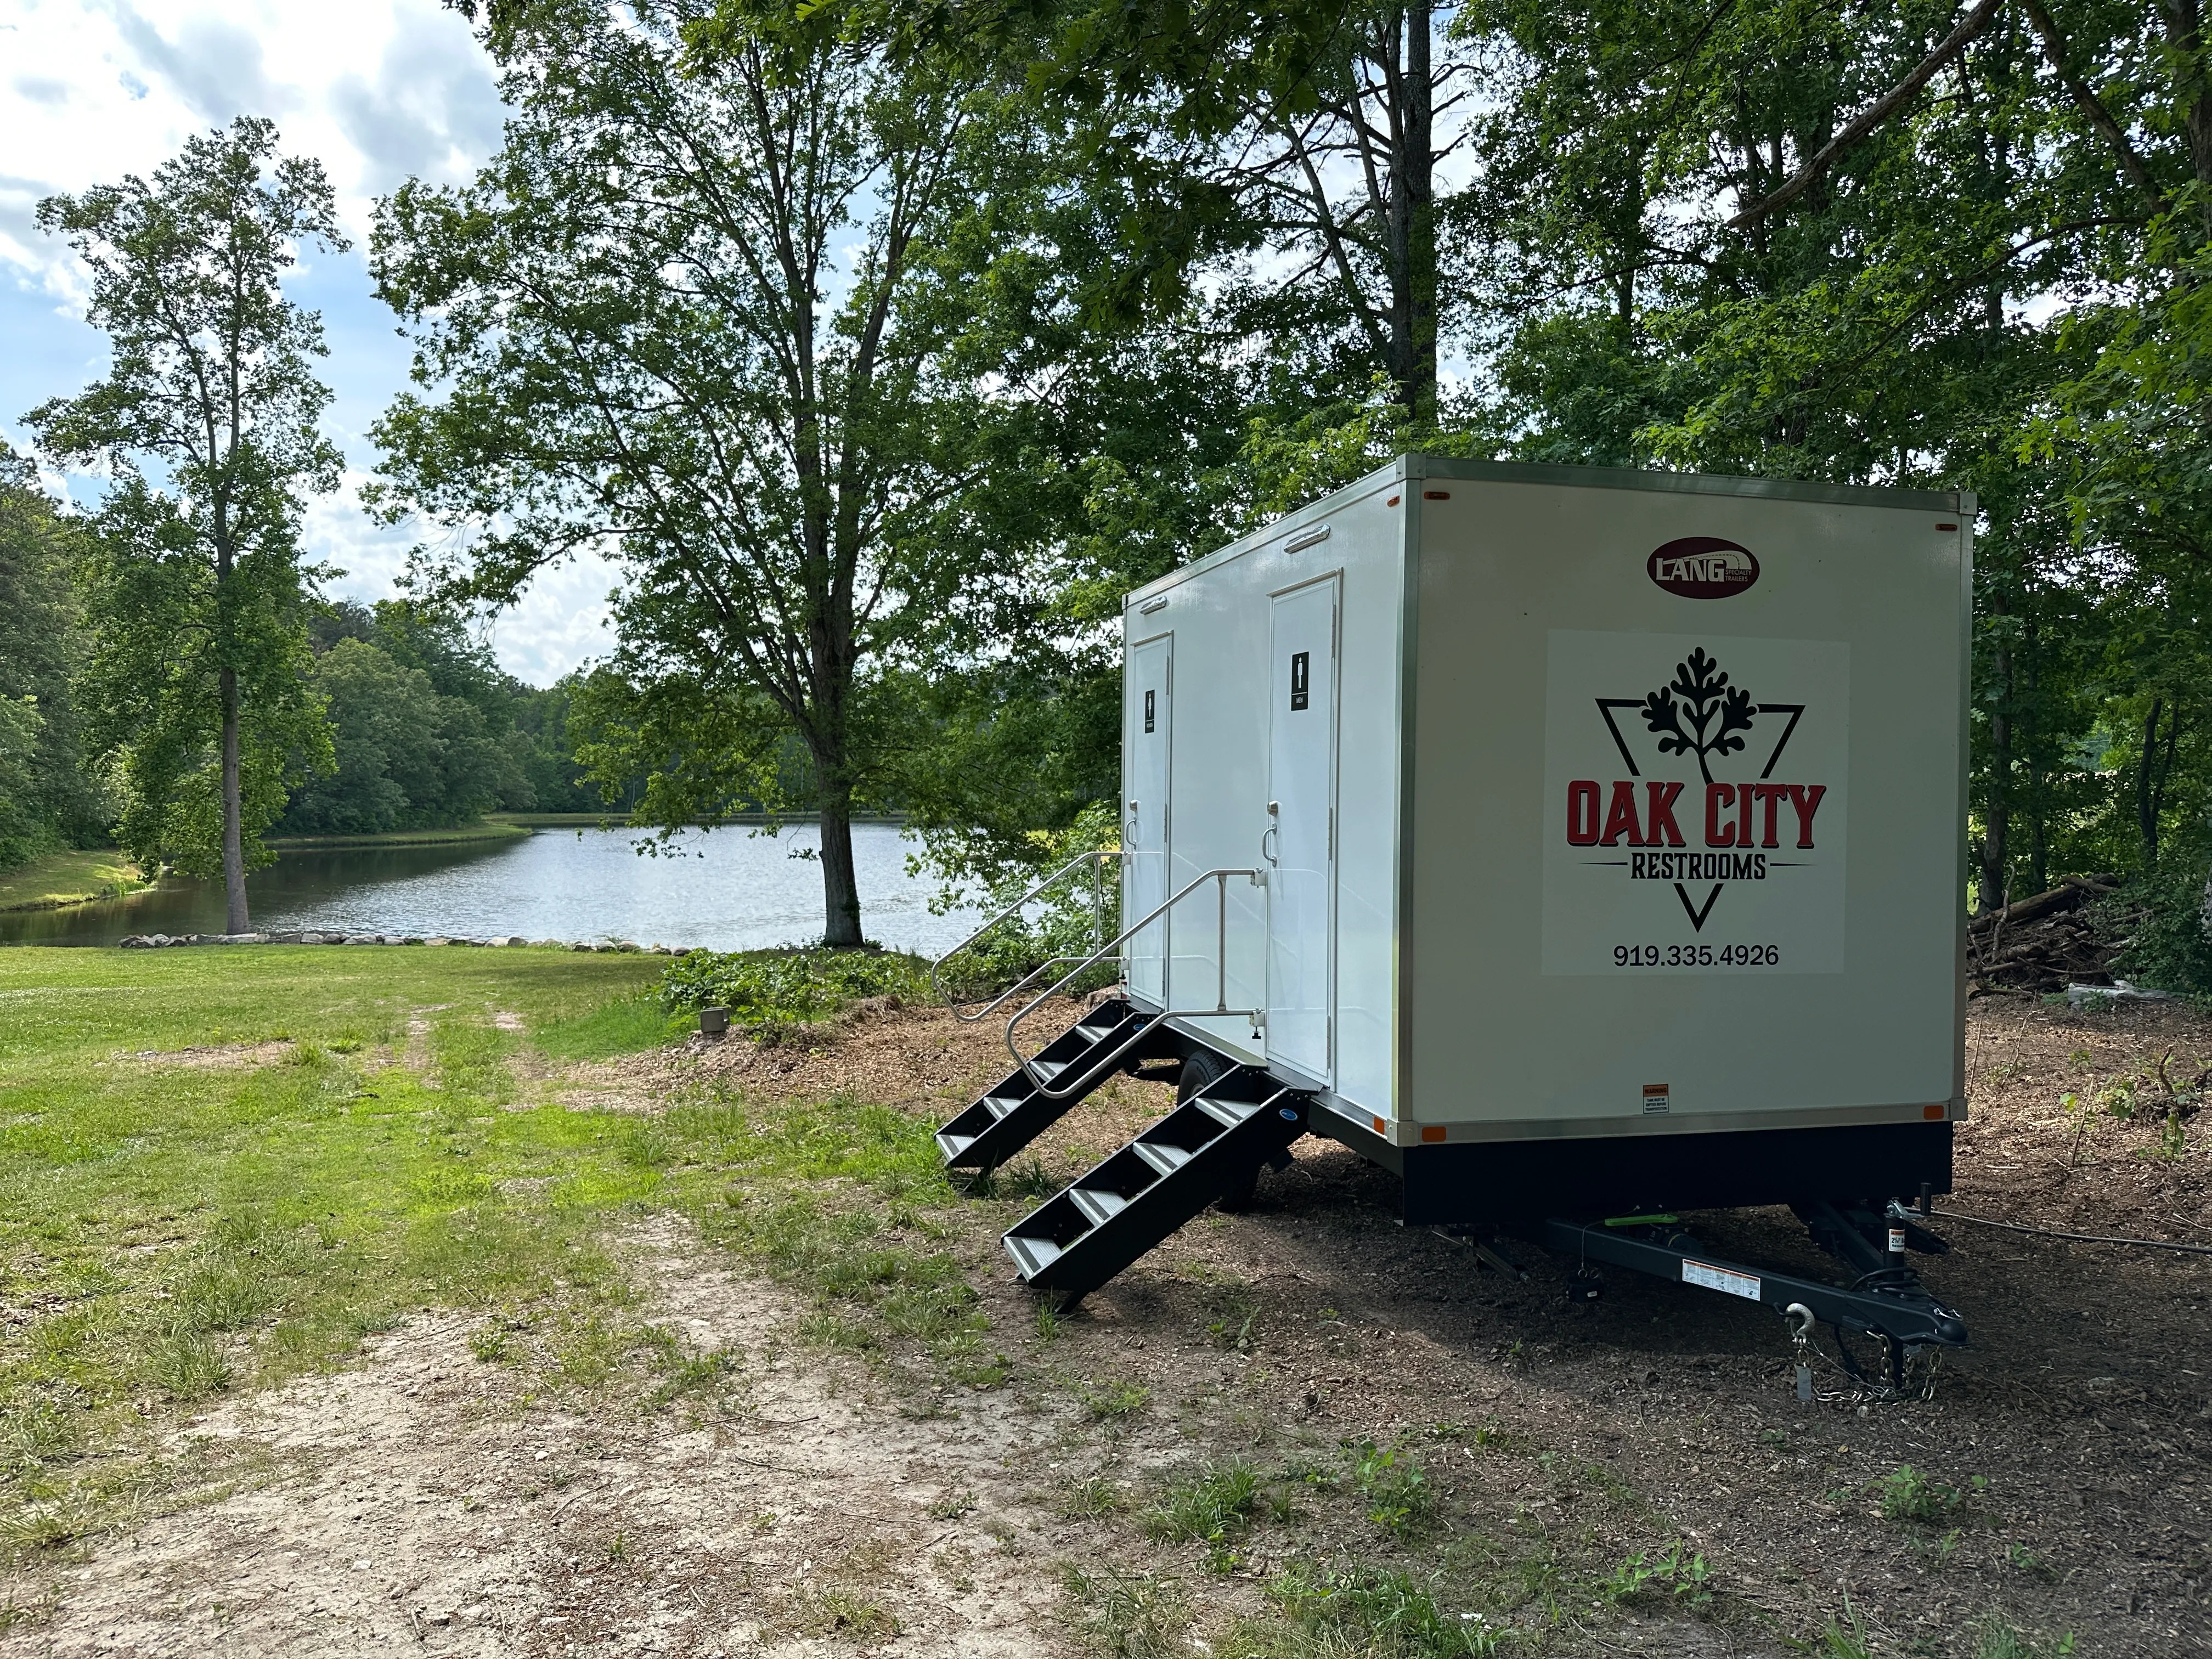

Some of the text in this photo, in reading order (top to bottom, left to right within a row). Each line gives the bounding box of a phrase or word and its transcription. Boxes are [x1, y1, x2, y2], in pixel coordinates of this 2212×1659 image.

[1656, 557, 1724, 582] LANG
[1566, 780, 1826, 849] OAK CITY
[1630, 852, 1767, 879] RESTROOMS
[1613, 945, 1779, 967] 919.335.4926
